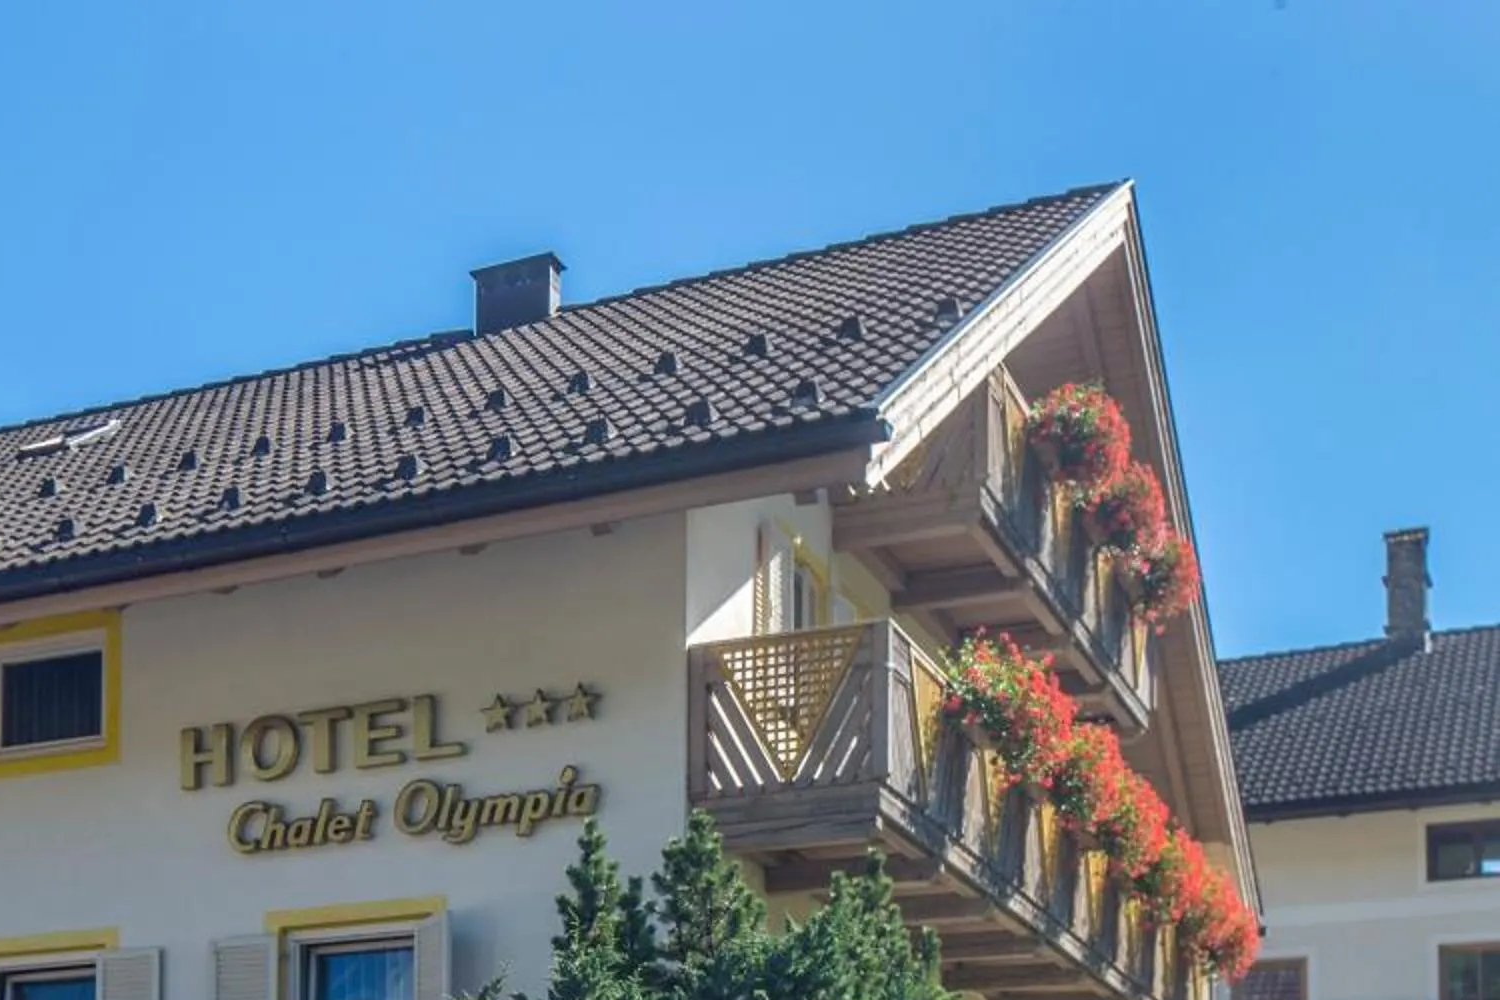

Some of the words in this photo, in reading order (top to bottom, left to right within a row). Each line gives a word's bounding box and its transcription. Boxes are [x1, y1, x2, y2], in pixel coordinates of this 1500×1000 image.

[180, 694, 467, 791] HOTEL
[228, 798, 378, 854] Chalet
[393, 765, 599, 844] Olympia
